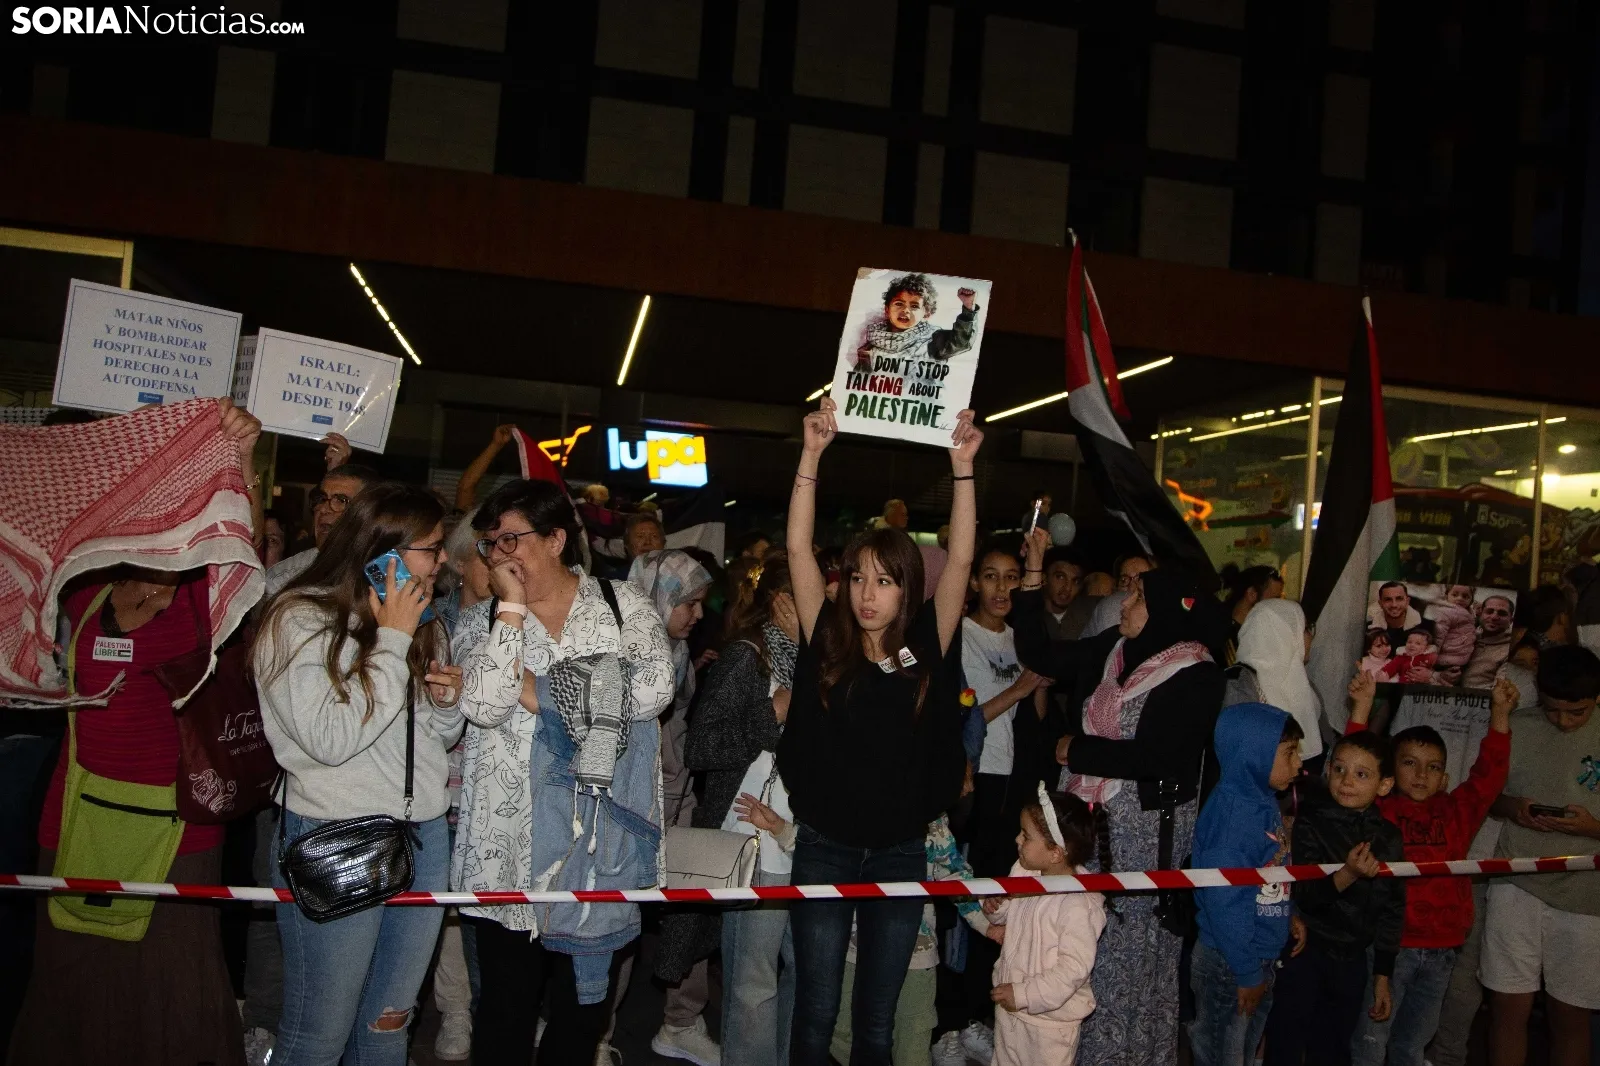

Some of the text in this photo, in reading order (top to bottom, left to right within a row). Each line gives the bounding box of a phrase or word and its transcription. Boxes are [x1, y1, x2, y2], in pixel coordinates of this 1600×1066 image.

[114, 308, 203, 333] MATAR NIÑOS
[105, 324, 207, 351] Y BOMBARDEAR
[93, 338, 212, 367] HOSPITALES NO ES
[104, 356, 199, 380] DERECHO A LA
[300, 355, 361, 378] ISRAEL:
[874, 355, 949, 381] DON'T STOP
[102, 372, 196, 395] AUTODEFENSA
[908, 382, 942, 399] ABOUT
[281, 389, 333, 409] DESDE
[607, 427, 707, 480] lupa
[94, 647, 118, 657] LIBRE
[95, 640, 132, 650] PALESTINA
